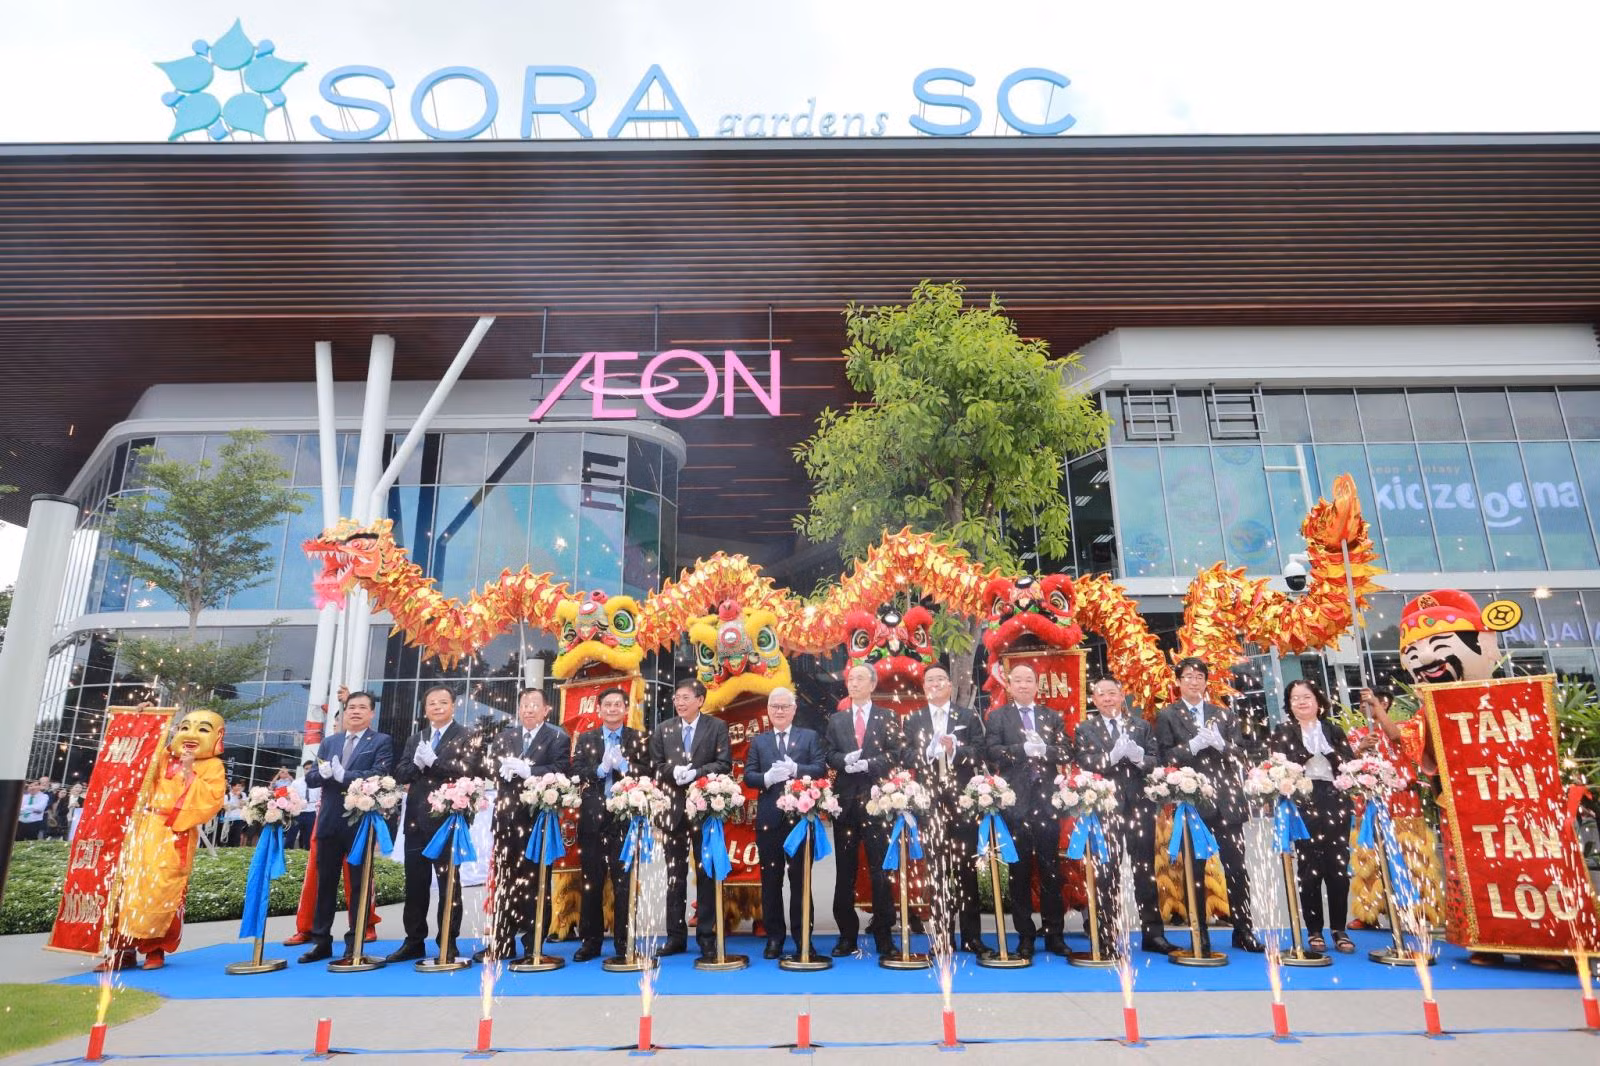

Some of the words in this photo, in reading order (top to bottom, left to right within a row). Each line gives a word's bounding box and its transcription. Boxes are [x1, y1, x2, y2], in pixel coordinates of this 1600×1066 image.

[310, 64, 699, 141] SORA
[715, 97, 888, 138] gardens
[909, 67, 1077, 136] SC
[1450, 693, 1533, 744] TẤN
[96, 776, 116, 815] Ý
[1467, 755, 1539, 801] TÀI
[1472, 805, 1564, 860] TẤN
[1488, 874, 1579, 928] LỘC
